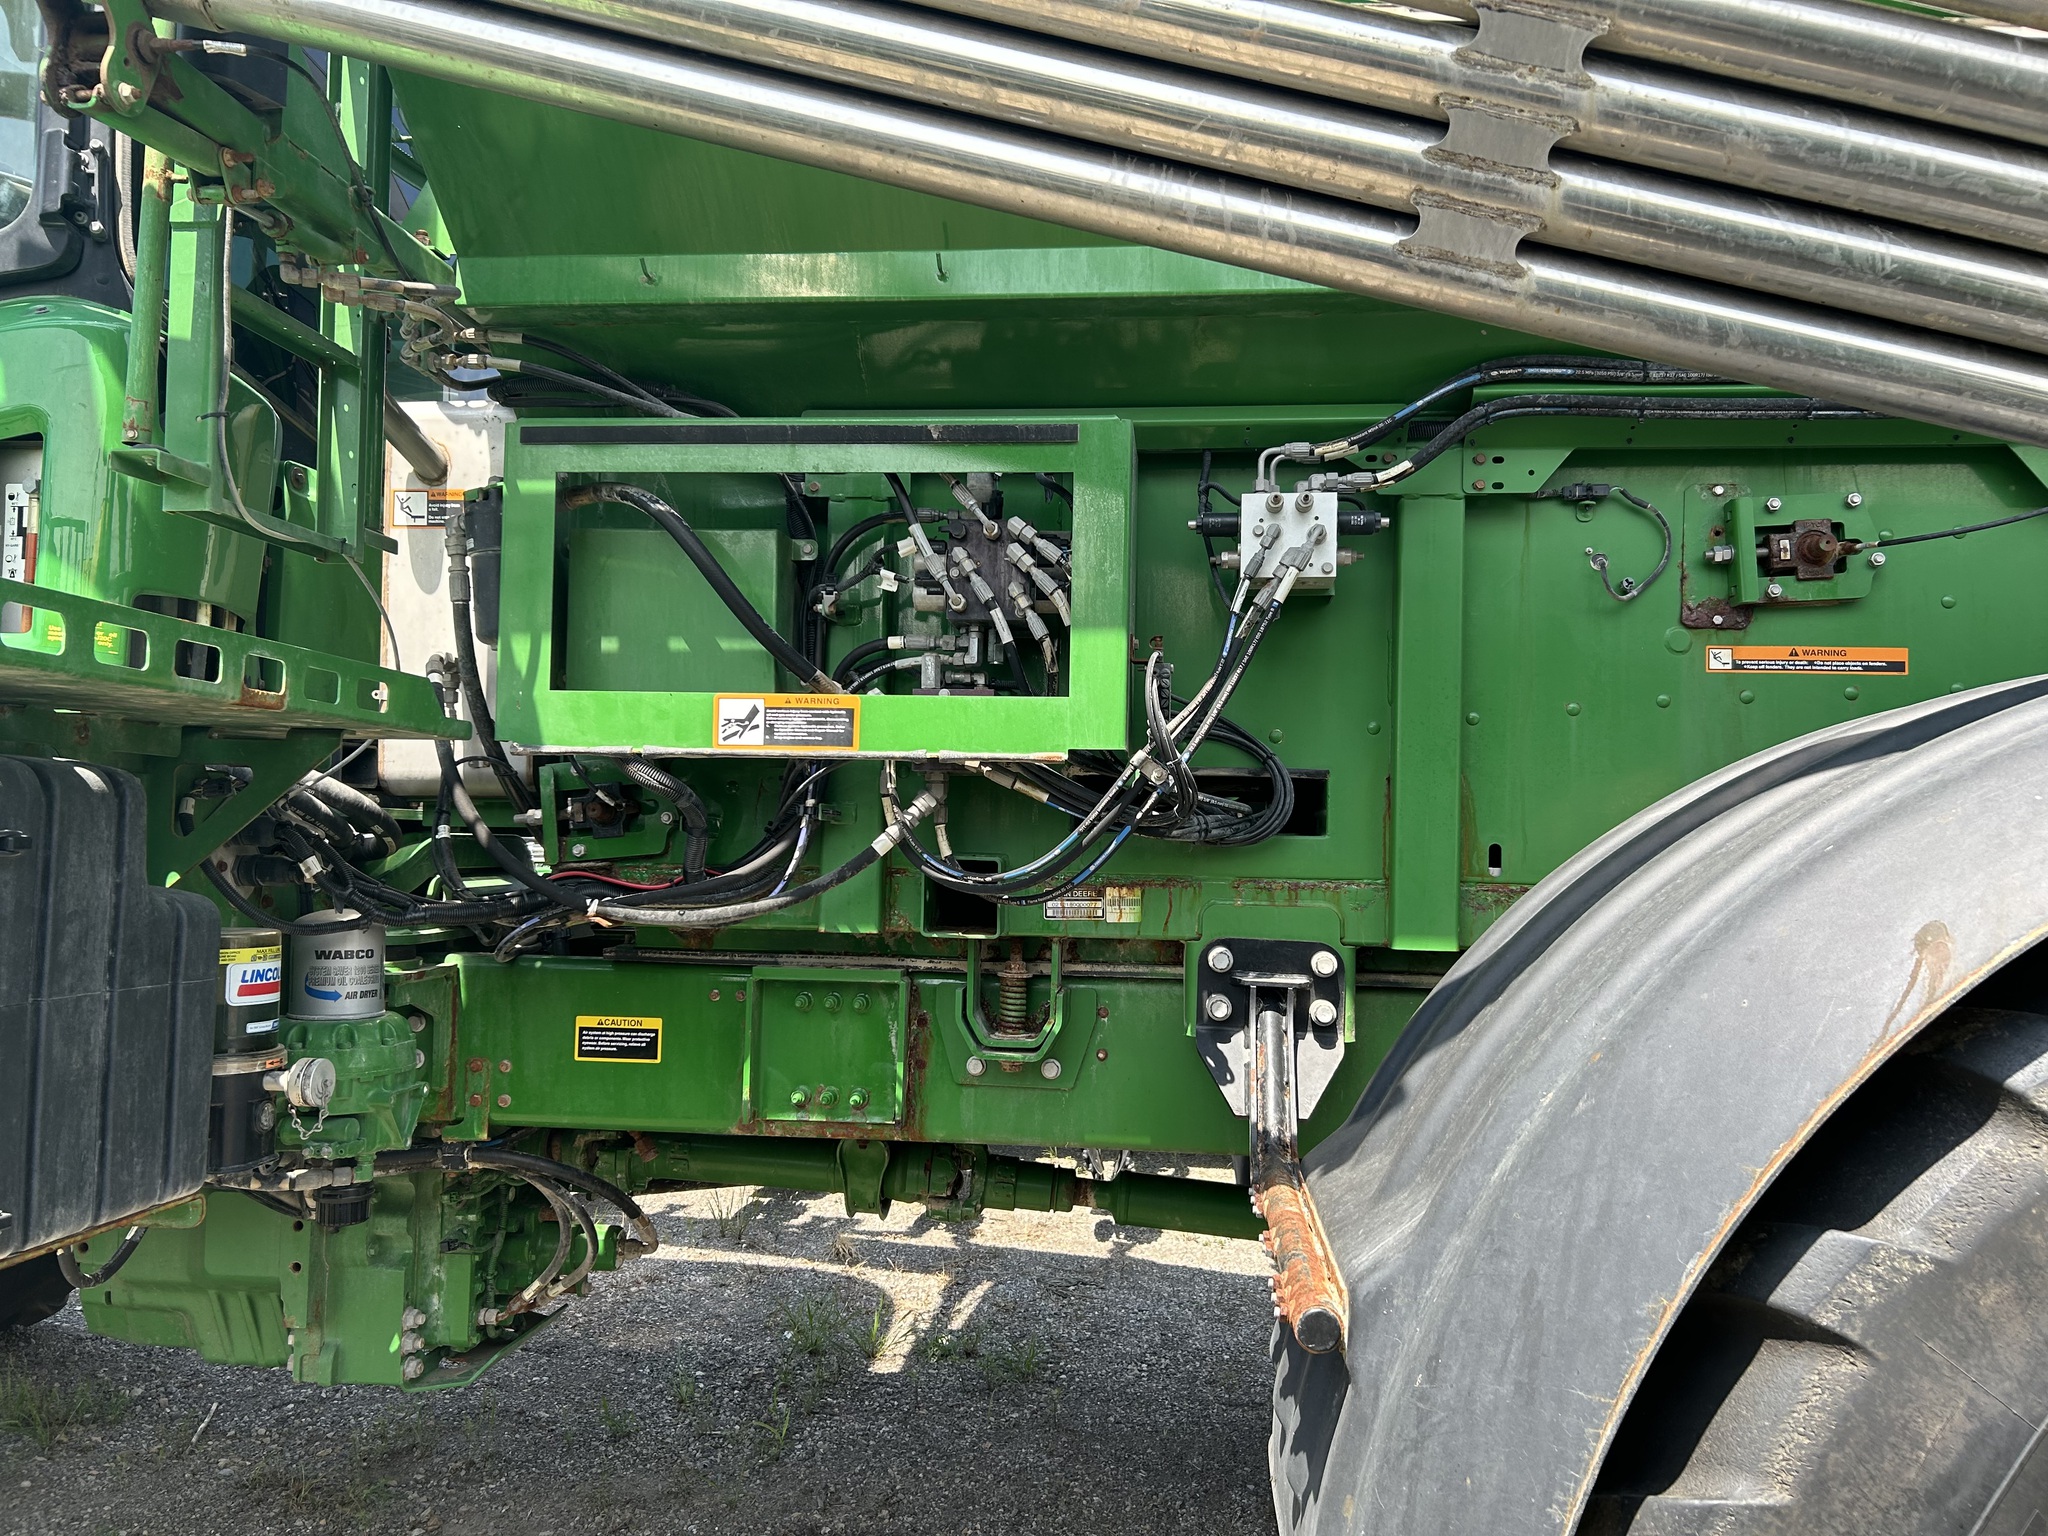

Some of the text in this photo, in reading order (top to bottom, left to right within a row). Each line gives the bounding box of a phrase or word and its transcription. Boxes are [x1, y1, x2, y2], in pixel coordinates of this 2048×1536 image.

[1802, 649, 1847, 657] WARNING
[315, 949, 374, 960] WABCO
[241, 967, 281, 983] LINCO
[308, 966, 331, 976] SYSTEM
[333, 965, 352, 976] SAVER
[308, 977, 336, 986] PREMIUM
[337, 976, 348, 986] OIL
[345, 990, 378, 999] AIR DRYER
[604, 1019, 643, 1027] CAUTION
